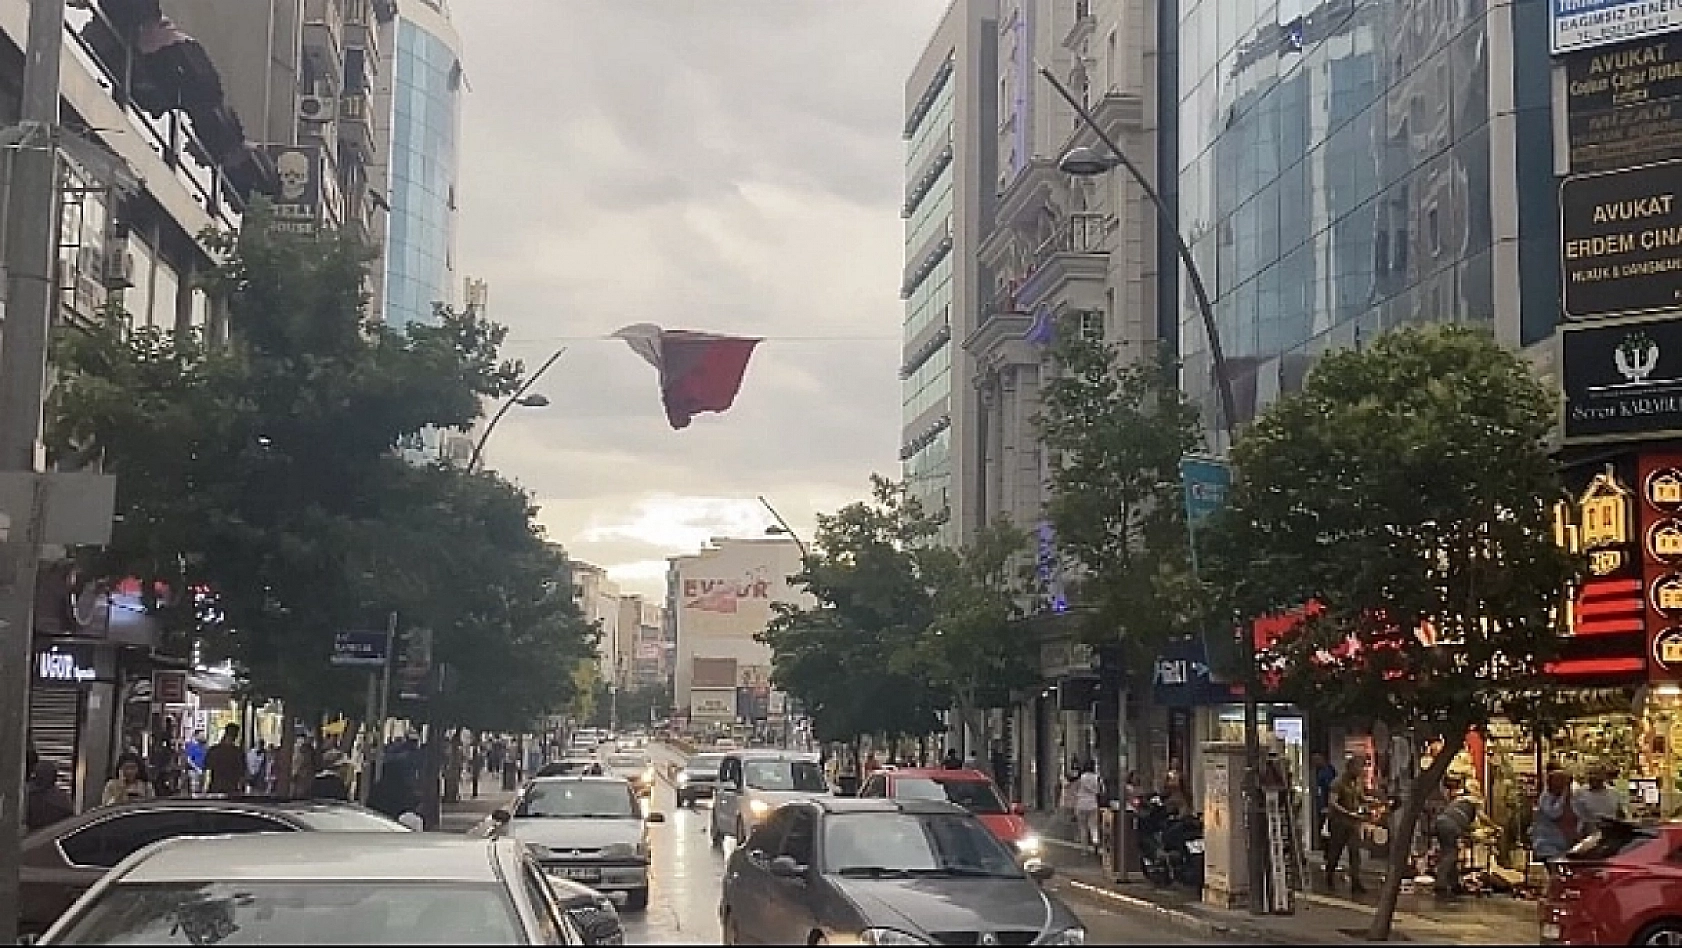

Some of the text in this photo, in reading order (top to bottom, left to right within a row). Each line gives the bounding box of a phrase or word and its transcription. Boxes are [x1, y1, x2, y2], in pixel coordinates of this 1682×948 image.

[1590, 45, 1666, 74] AVUKAT
[1593, 195, 1674, 224] AVUKAT
[1566, 233, 1635, 258] ERDEM
[684, 577, 768, 598] EVUR
